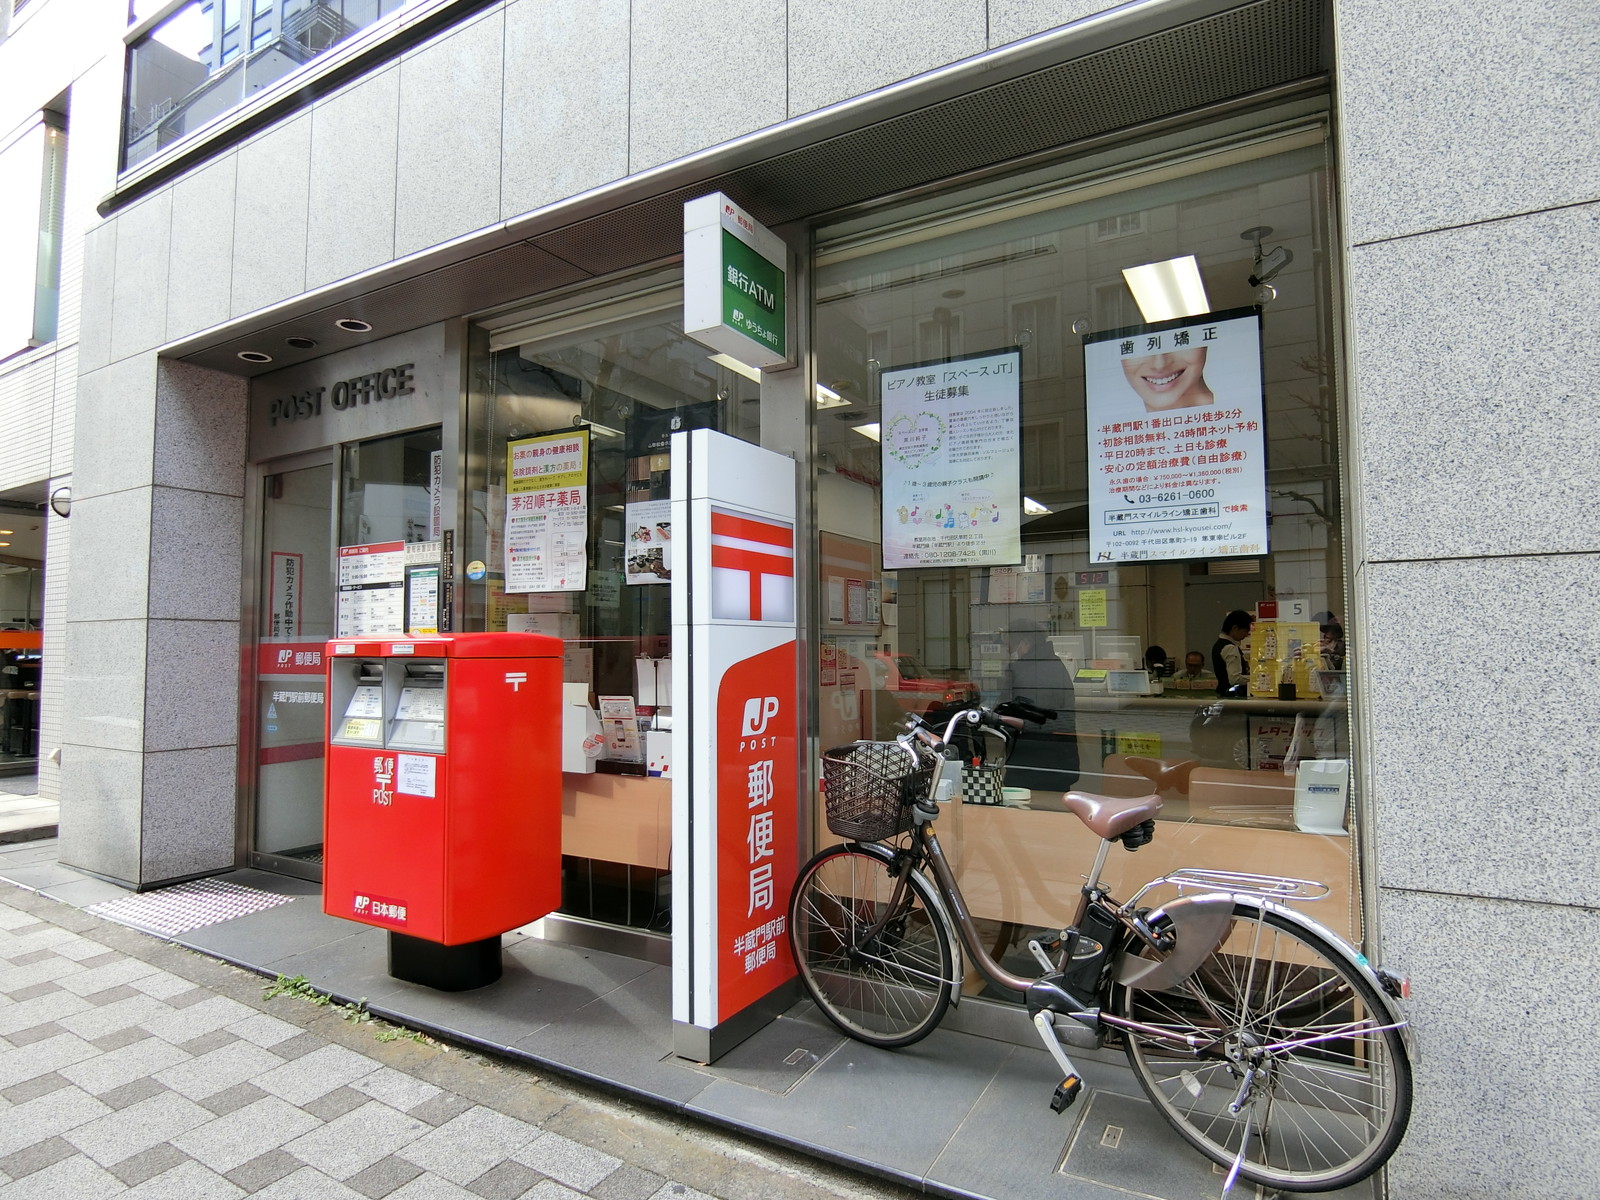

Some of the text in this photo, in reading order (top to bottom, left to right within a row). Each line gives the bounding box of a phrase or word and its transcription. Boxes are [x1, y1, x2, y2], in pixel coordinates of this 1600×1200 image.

[727, 264, 775, 310] 銀行ATM
[745, 318, 778, 346] ゆうちょ銀行
[270, 363, 415, 427] POST OFFICE
[924, 385, 970, 402] 生徒募集
[511, 489, 581, 511] 茅沼順子薬局
[1138, 488, 1215, 504] 03-6261-0600
[1108, 504, 1248, 522] 半蔵門スマイルライン矯正歯科 で検索
[1131, 522, 1232, 537] http://www.hsl-kyousei.com/
[1120, 543, 1260, 560] 半蔵門スマイルライン矯正歯科
[1293, 603, 1302, 615] 5
[295, 651, 321, 666] 郵便局
[741, 696, 779, 737] JP
[739, 736, 777, 752] POST
[373, 756, 395, 776] 郵便
[373, 788, 394, 806] POST
[746, 759, 775, 919] 郵便局
[372, 901, 407, 921] 日本郵便
[733, 914, 786, 957] 半蔵門駅前
[744, 940, 777, 975] 郵便局
